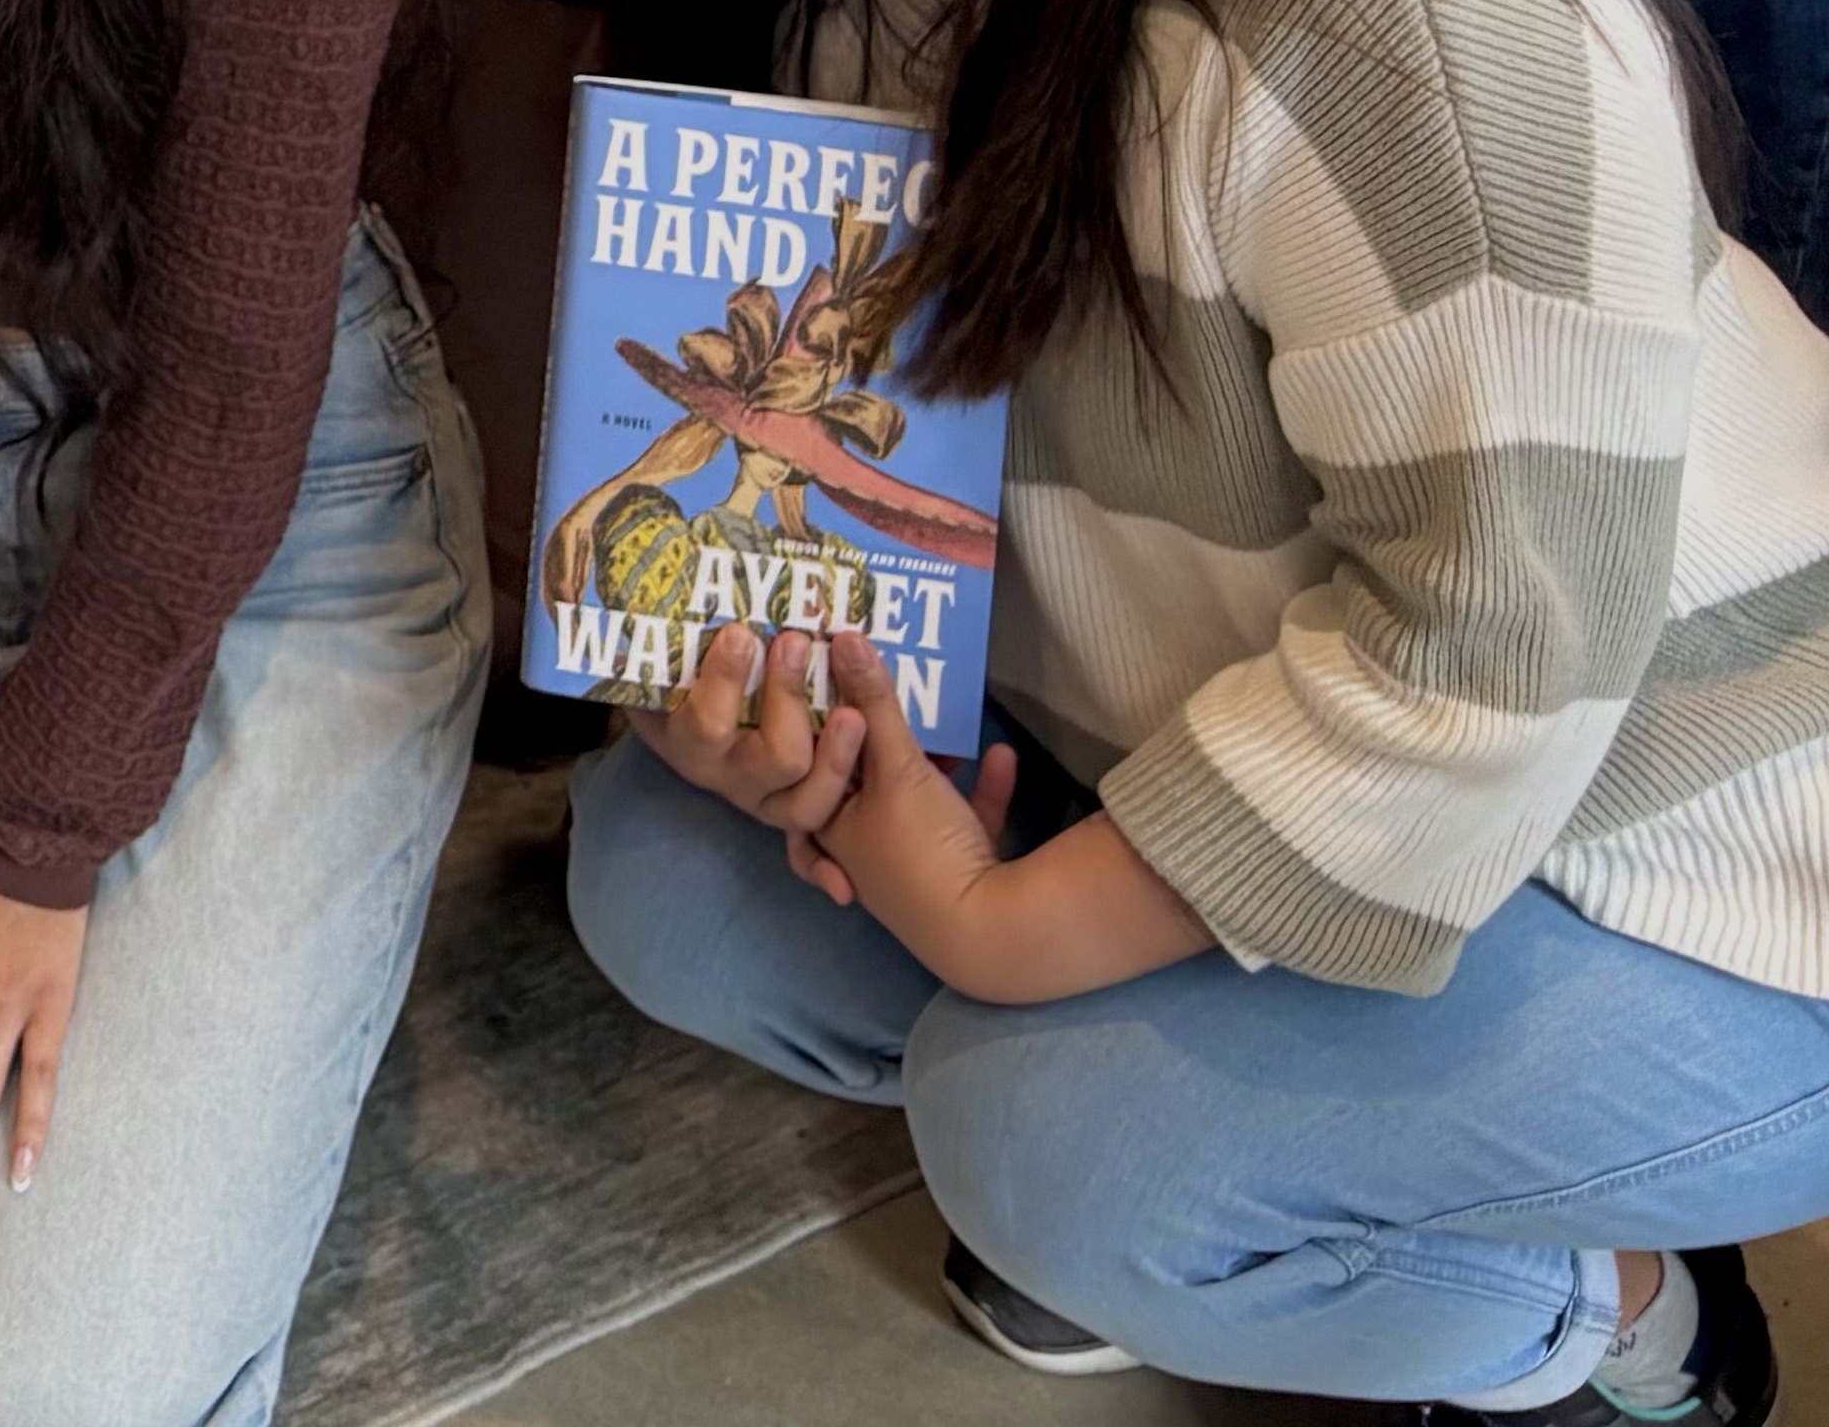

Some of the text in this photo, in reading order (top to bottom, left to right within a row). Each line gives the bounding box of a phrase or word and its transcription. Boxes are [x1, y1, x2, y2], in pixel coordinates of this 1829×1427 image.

[597, 117, 938, 231] A PERFEC
[589, 193, 808, 289] HAND
[614, 414, 654, 432] NOVEL
[688, 544, 958, 651] AYELET
[869, 552, 896, 567] AND
[898, 556, 957, 577] TREASURE
